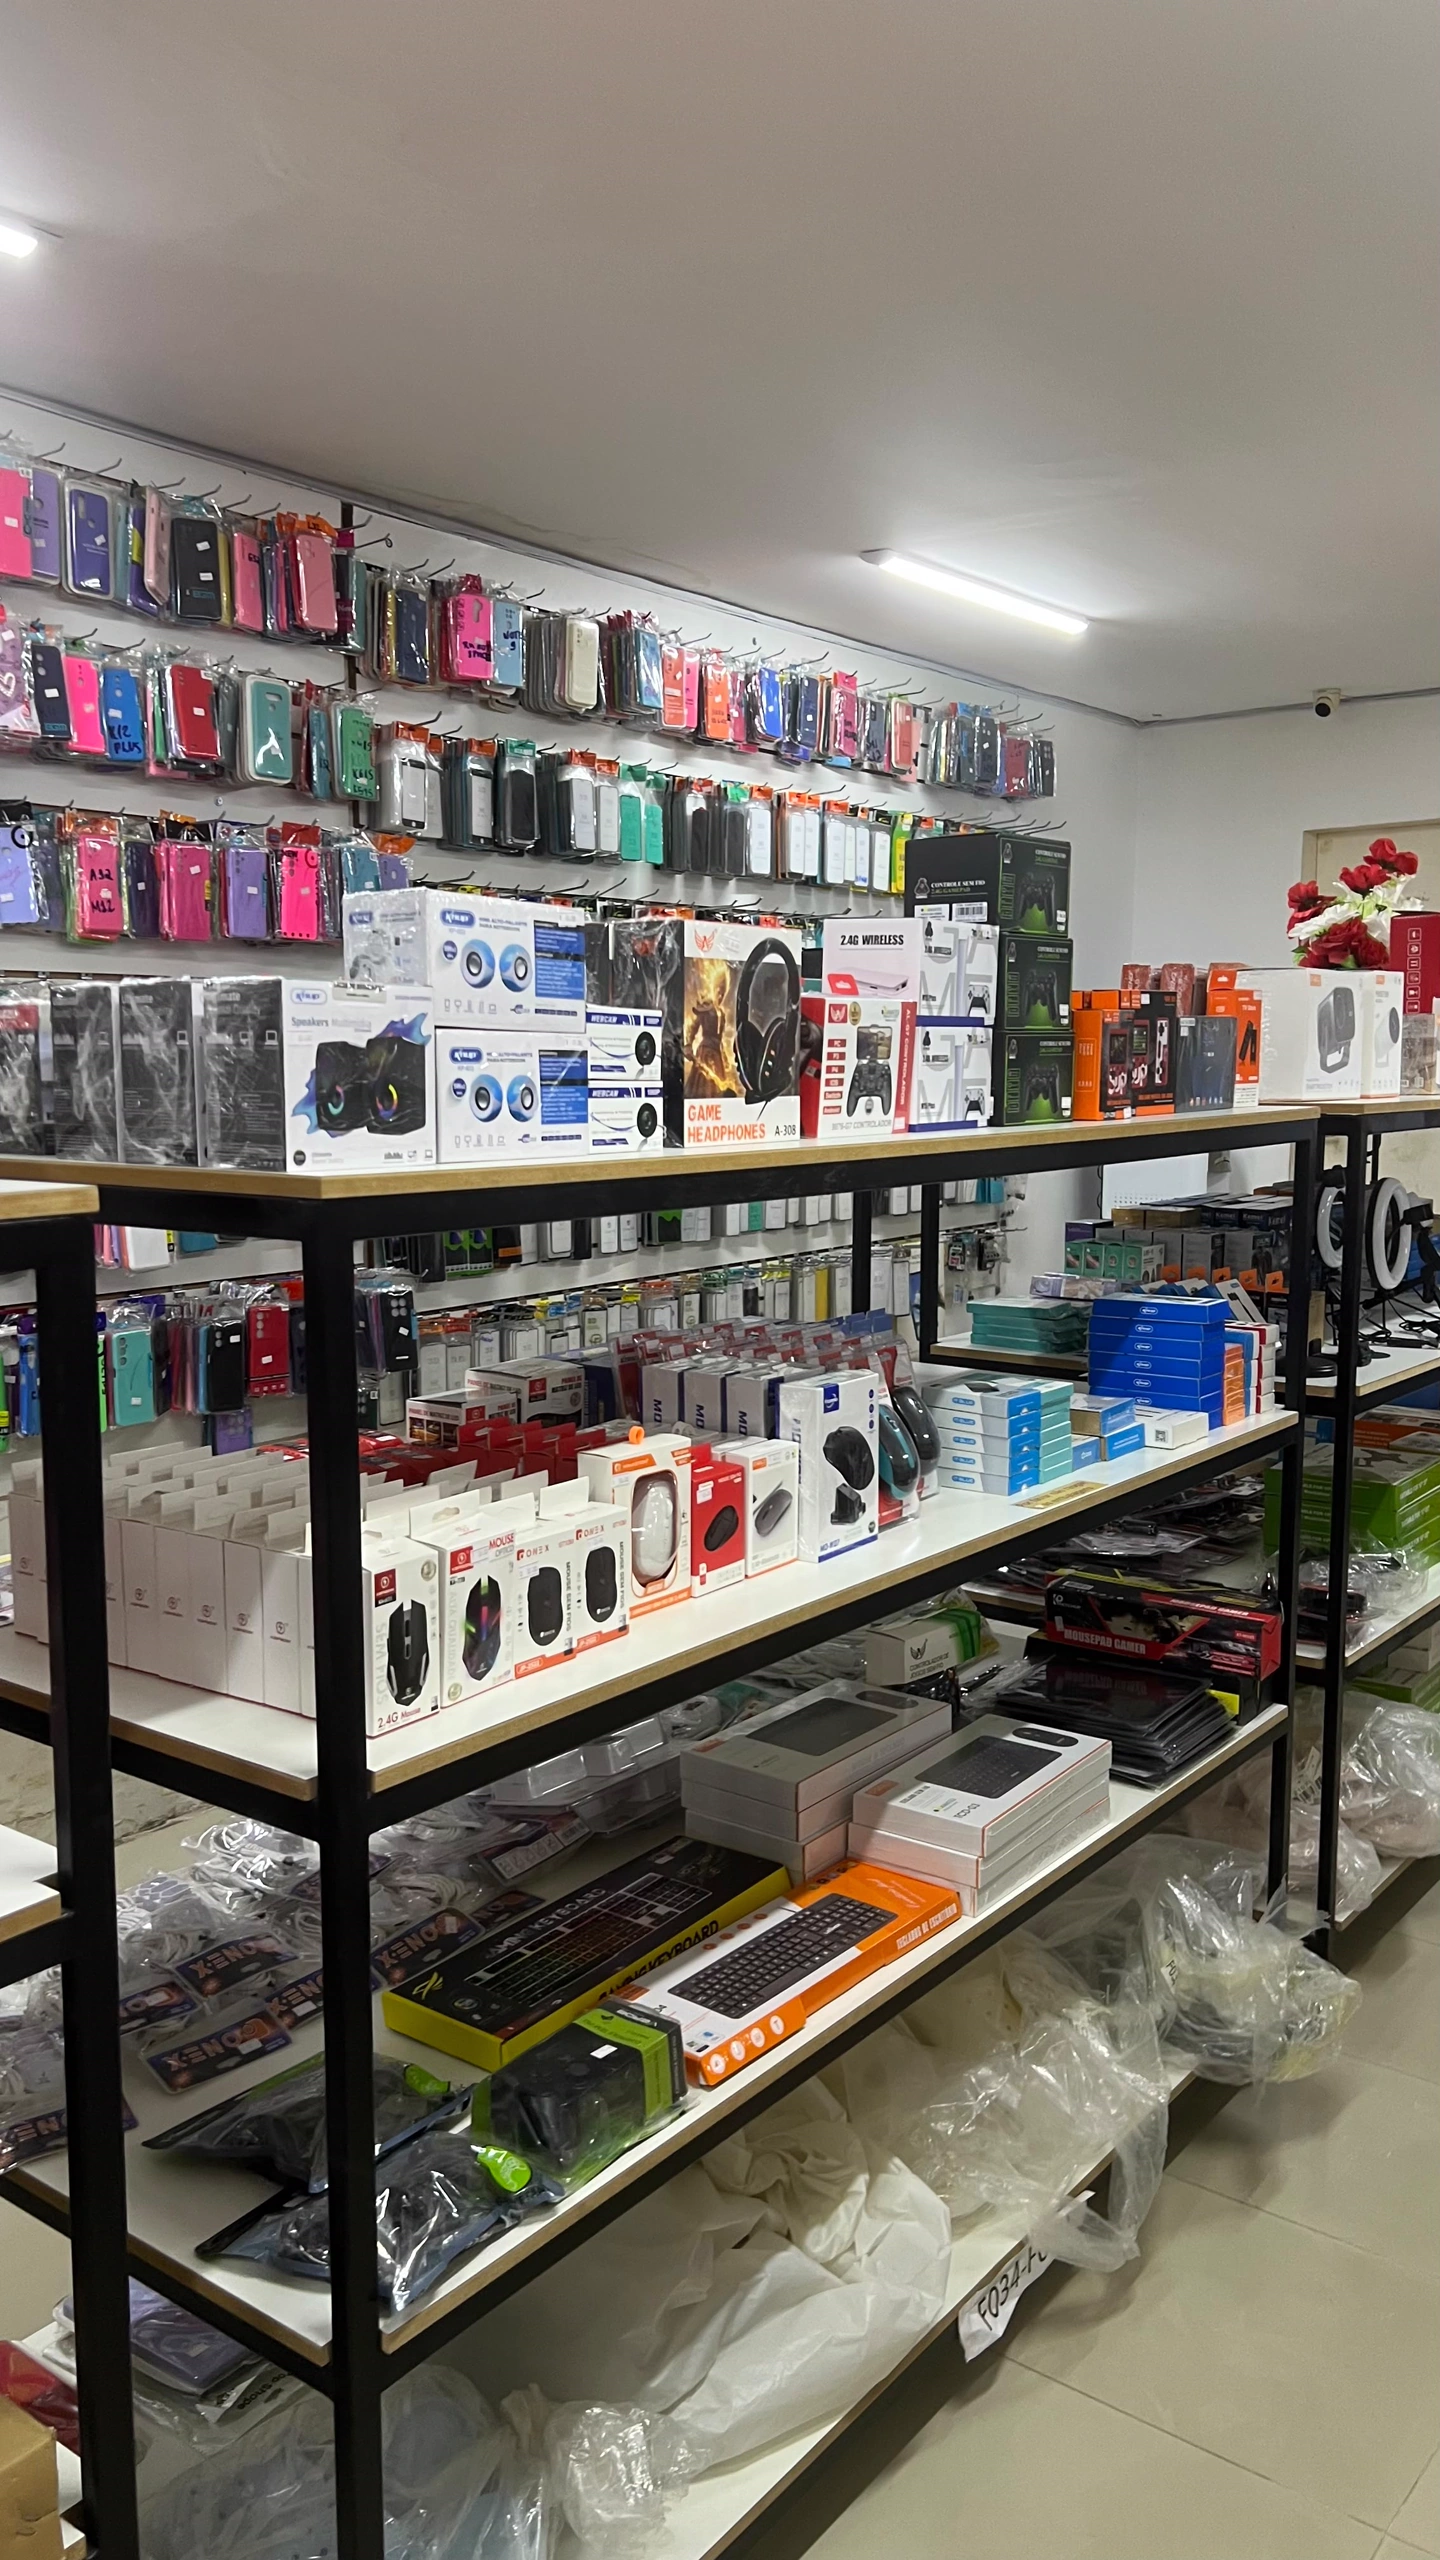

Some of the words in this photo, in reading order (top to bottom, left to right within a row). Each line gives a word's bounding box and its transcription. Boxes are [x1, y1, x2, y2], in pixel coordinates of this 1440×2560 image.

[840, 934, 859, 946] 2.4G
[862, 934, 904, 946] WIRELESS
[292, 1016, 329, 1028] Speakers
[688, 1104, 722, 1122] GAME
[688, 1123, 766, 1143] HEADPHONES
[775, 1125, 797, 1137] A-308
[489, 1533, 514, 1550] MOUSE
[565, 1561, 573, 1591] MOUSE
[1063, 1628, 1113, 1648] MOUSEPAD
[1114, 1638, 1146, 1655] GAMER
[377, 1711, 399, 1729] 2.4G
[400, 1707, 421, 1719] Mouse
[535, 1887, 606, 1930] KEYBOARD
[648, 1920, 719, 1970] KEYBOARD
